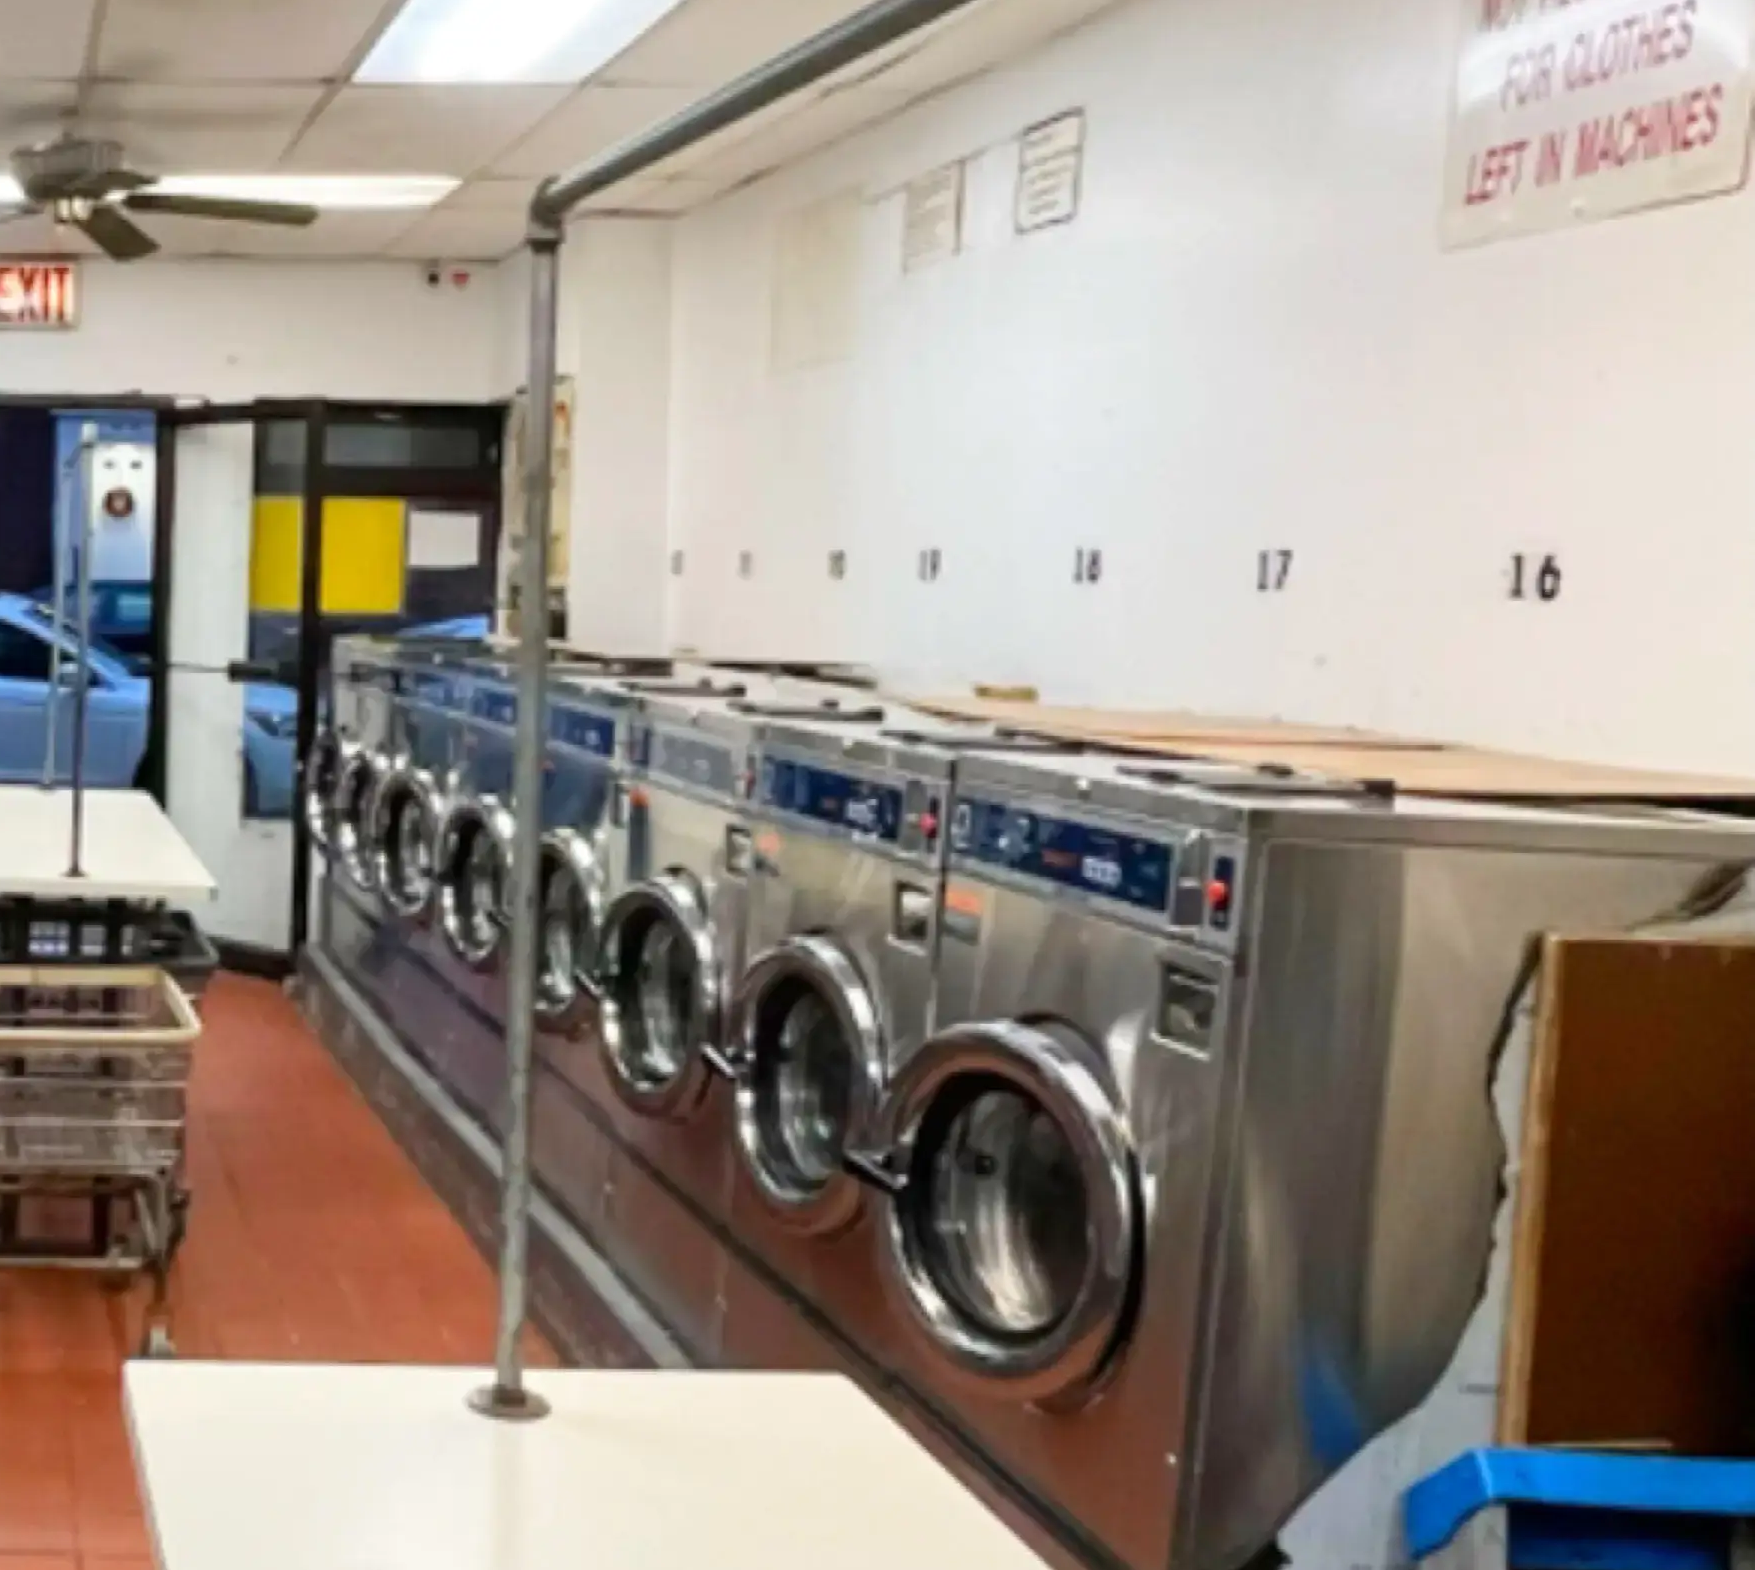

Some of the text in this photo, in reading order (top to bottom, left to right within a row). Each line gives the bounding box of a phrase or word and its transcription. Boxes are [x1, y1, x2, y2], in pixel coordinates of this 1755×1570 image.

[1500, 41, 1555, 113] FOR
[1463, 82, 1725, 208] LEFT IN MACHINES
[1255, 547, 1294, 591] 17
[1509, 550, 1562, 602] 16
